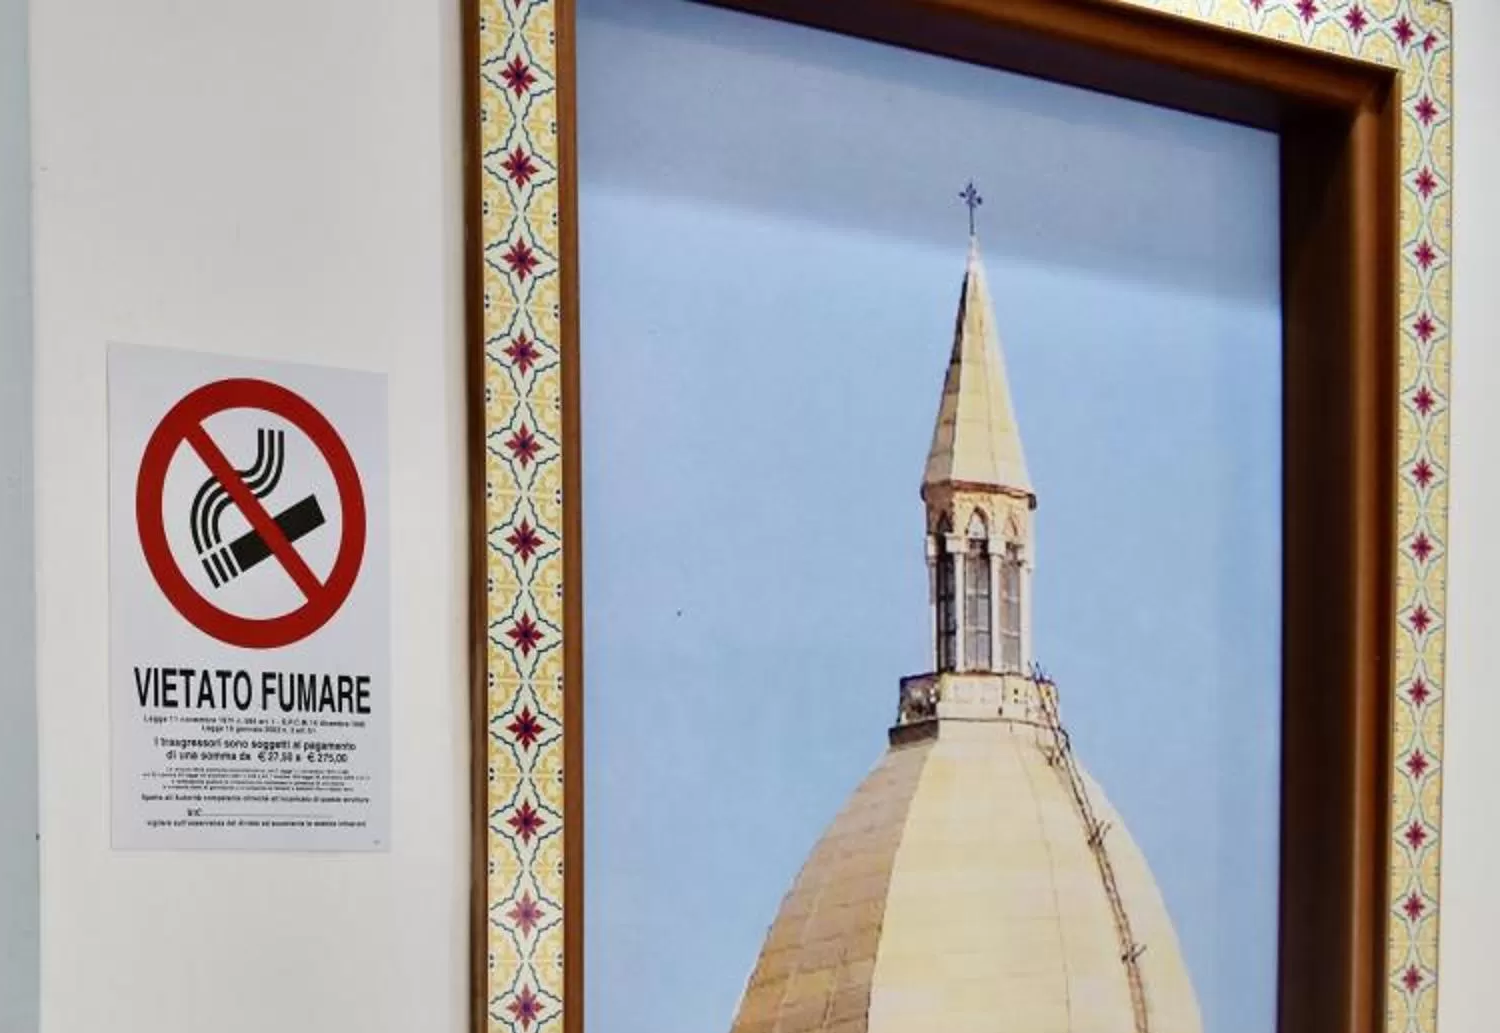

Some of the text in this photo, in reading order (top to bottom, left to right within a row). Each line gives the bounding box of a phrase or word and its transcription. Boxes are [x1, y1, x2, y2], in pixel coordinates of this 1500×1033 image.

[134, 667, 371, 714] VIETATO FUMARE
[143, 714, 167, 724] Legge
[160, 737, 221, 750] trasgressori
[223, 740, 249, 749] sono
[251, 740, 291, 752] soggetti
[303, 742, 357, 753] pagamento
[165, 750, 177, 761] di
[179, 752, 198, 761] una
[200, 752, 236, 761] somma
[239, 752, 252, 761] da
